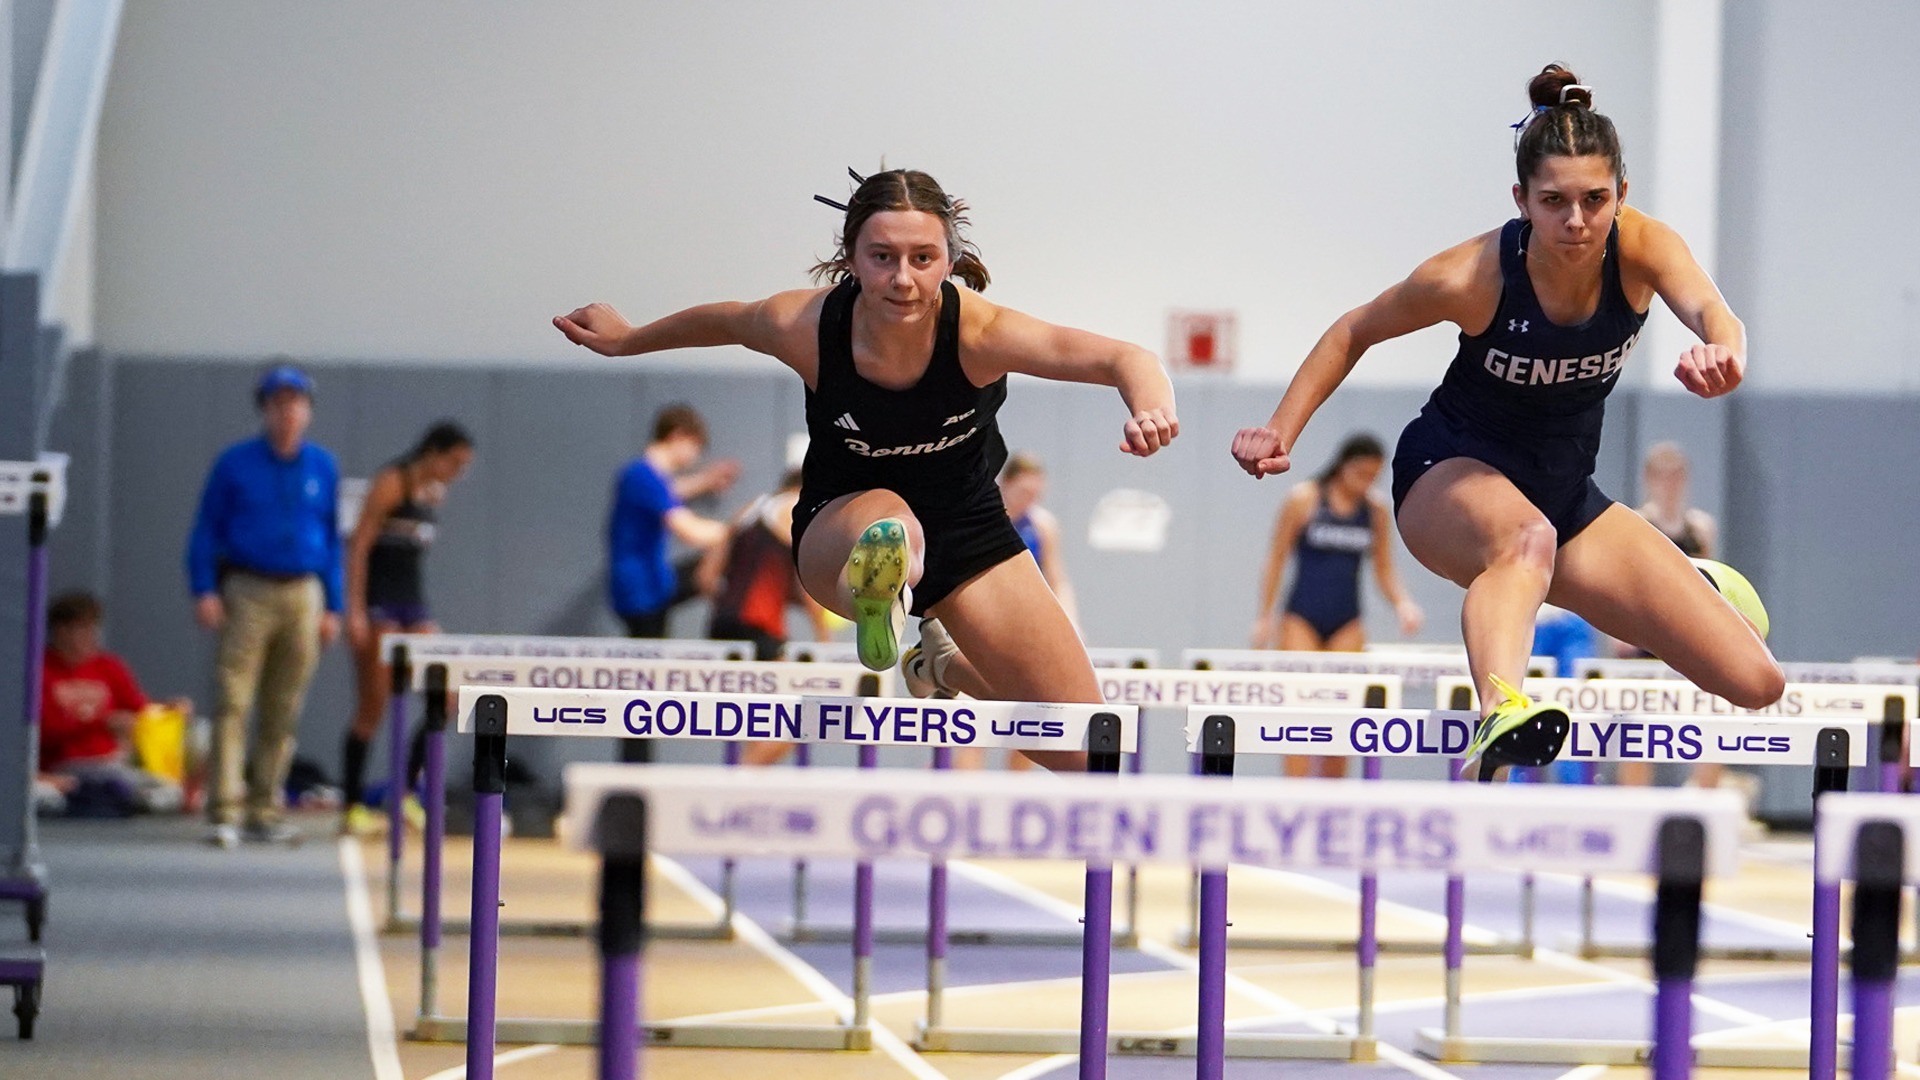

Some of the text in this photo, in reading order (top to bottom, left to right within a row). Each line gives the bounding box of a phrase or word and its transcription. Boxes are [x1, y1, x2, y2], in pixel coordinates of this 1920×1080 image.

[529, 667, 656, 691] GOLDEN
[667, 669, 778, 694] FLYERS
[1103, 679, 1162, 702] DEN
[1174, 681, 1285, 705] FLYERS
[1555, 686, 1680, 712] GOLDEN
[534, 699, 1064, 745] UCS GOLDEN FLYERS UCS
[1261, 717, 1791, 760] UCS GOLD LYERS UCS
[850, 796, 1159, 855] GOLDEN
[1187, 804, 1459, 863] FLYERS
